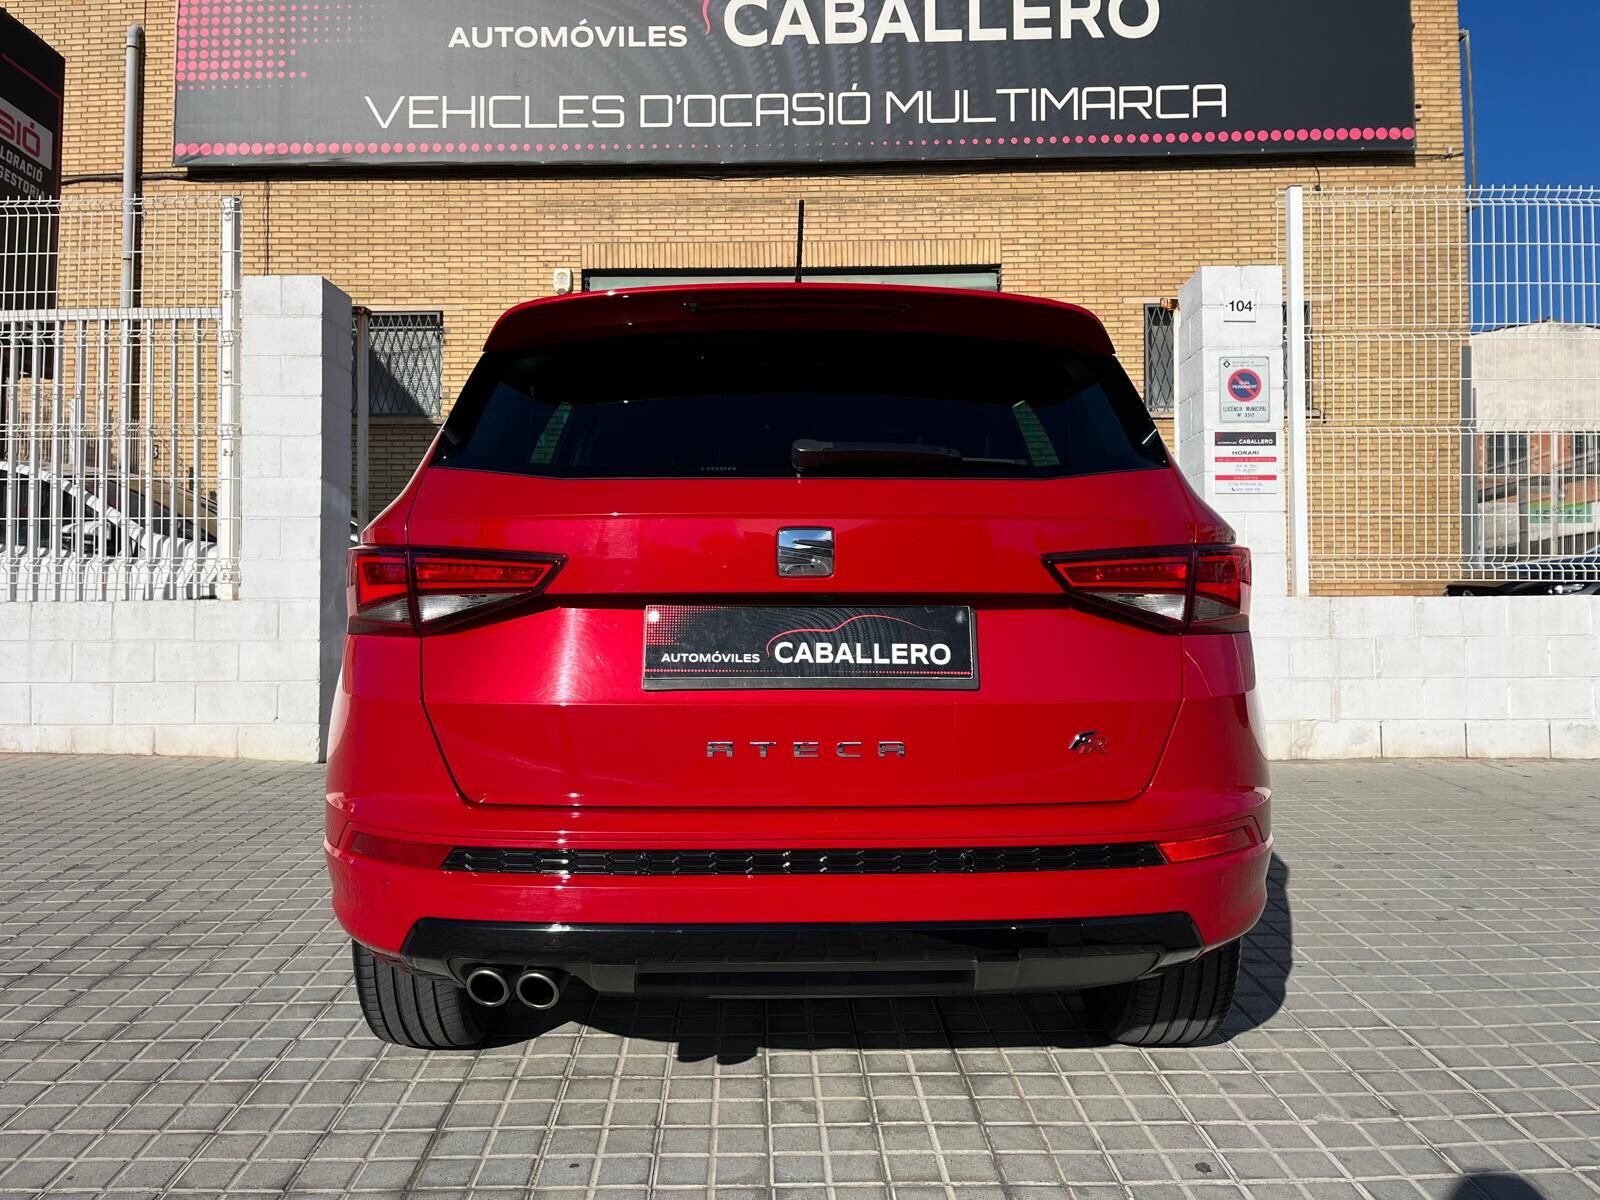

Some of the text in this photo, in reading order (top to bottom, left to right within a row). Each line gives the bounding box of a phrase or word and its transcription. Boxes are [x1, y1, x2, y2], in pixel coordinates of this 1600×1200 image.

[448, 0, 1160, 49] AUTOMÓVILES CABALLERO
[364, 83, 1228, 129] VEHICLES D'OCASIÓ MULTIMARCA
[1228, 300, 1253, 312] 104
[661, 641, 952, 666] AUTOMÓVILES CABALLERO
[706, 740, 906, 758] ATECA
